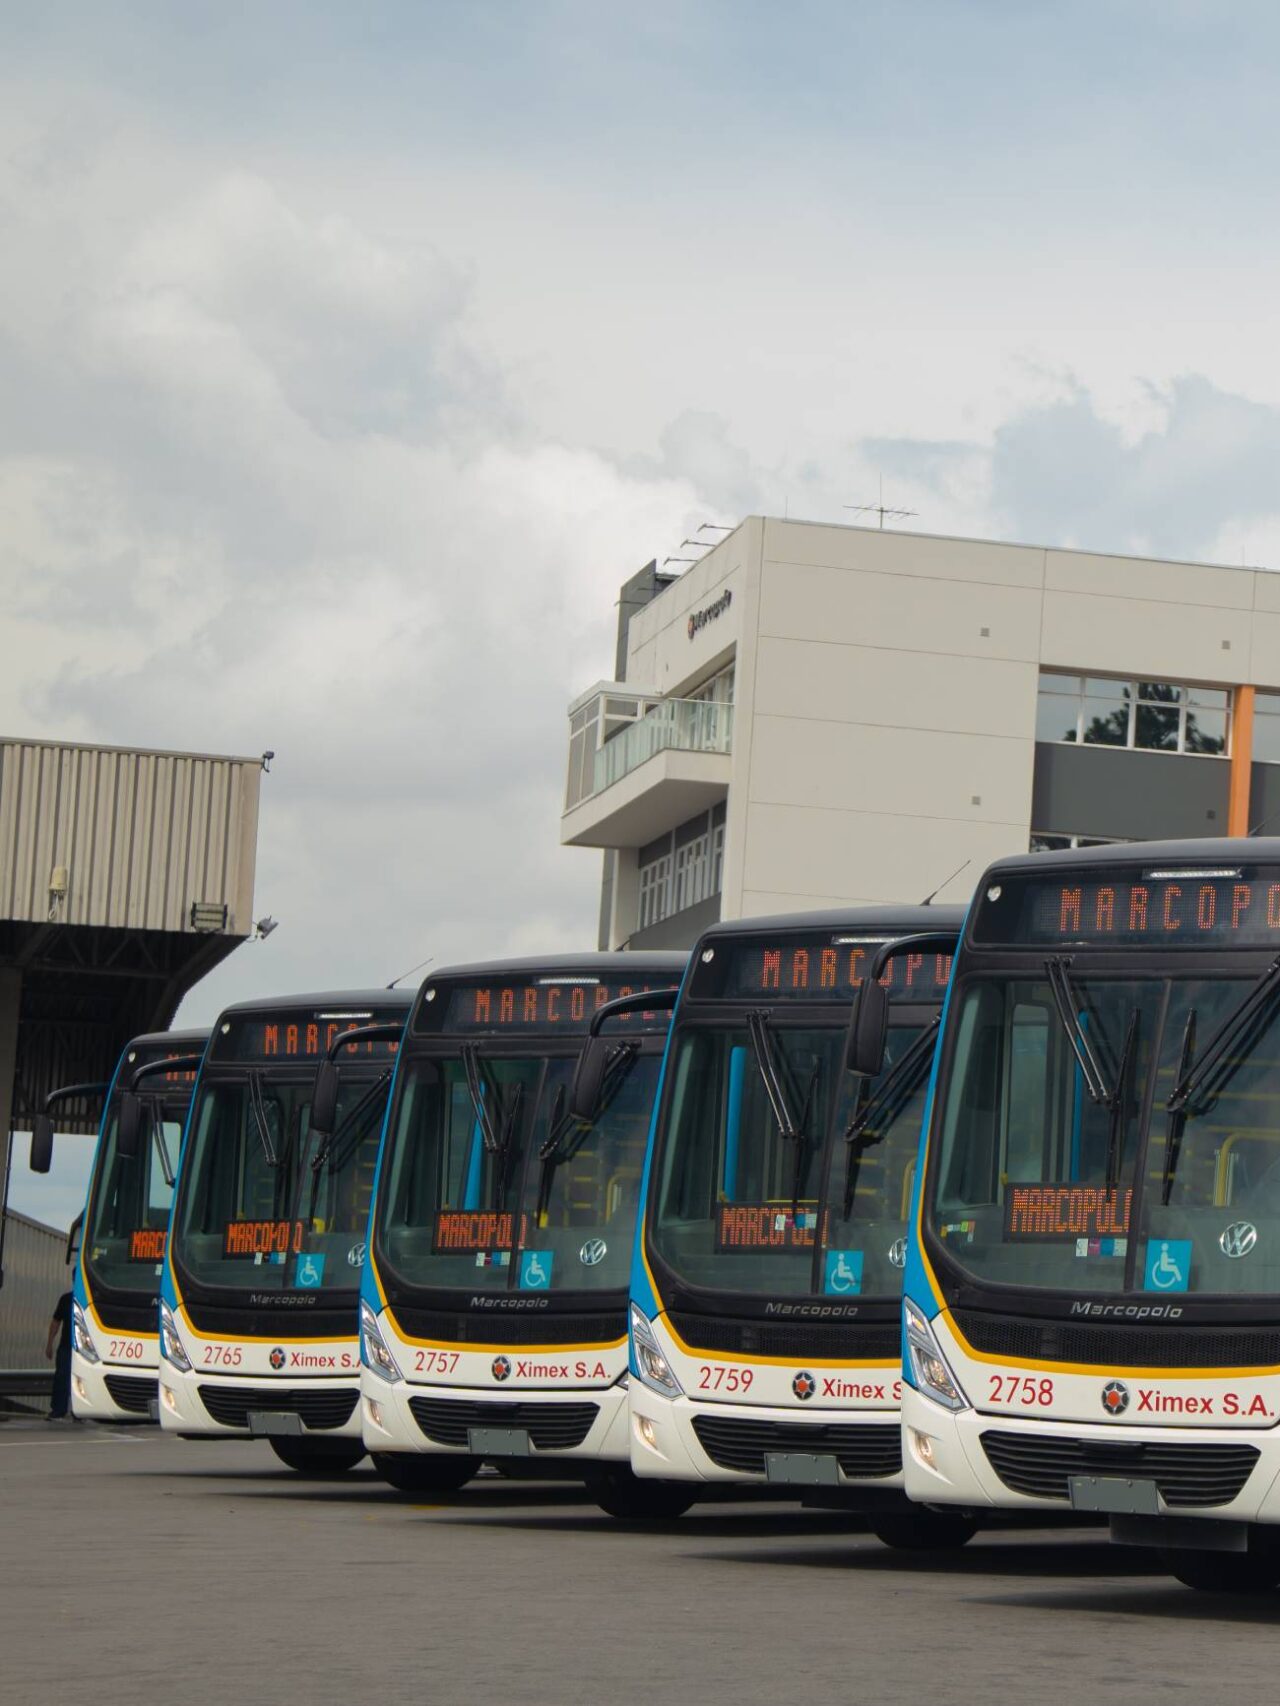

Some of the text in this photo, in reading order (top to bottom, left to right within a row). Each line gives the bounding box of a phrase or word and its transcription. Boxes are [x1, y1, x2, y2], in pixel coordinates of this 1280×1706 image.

[469, 1296, 550, 1310] Marcopolo
[764, 1302, 859, 1317] Marcopolo
[1070, 1301, 1183, 1319] Marcopolo
[109, 1340, 144, 1360] 2760
[203, 1345, 243, 1366] 2765
[290, 1351, 335, 1368] Ximex
[414, 1350, 461, 1374] 2757
[515, 1360, 612, 1379] Ximex S.A.
[699, 1365, 754, 1394] 2759
[821, 1377, 885, 1400] Ximex
[988, 1374, 1054, 1407] 2758
[1136, 1388, 1276, 1417] Ximex S.A.
